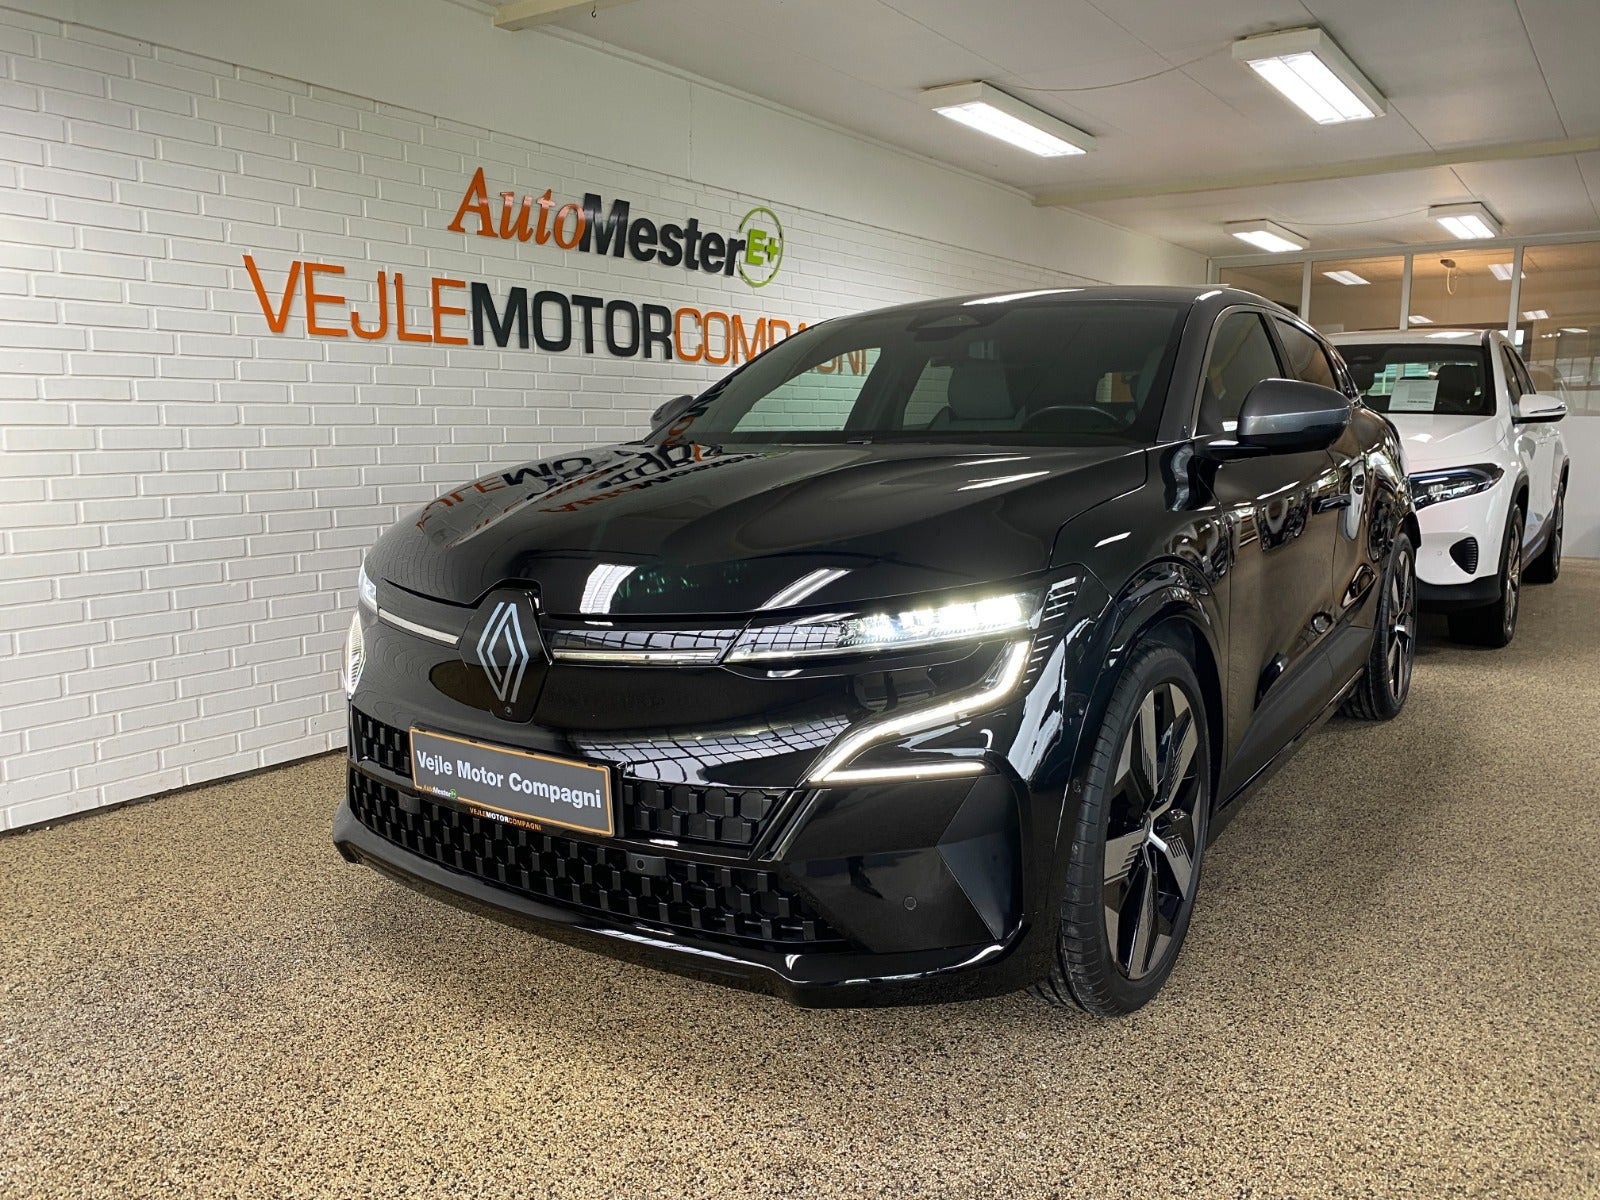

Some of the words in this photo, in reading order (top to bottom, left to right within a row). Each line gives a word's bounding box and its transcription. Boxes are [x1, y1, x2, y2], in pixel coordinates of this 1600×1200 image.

[448, 166, 746, 277] AutoMester
[416, 750, 453, 776] Vejle
[456, 760, 504, 788] Motor
[508, 772, 602, 809] Compagni
[469, 806, 543, 831] VEJLEMOTORCOMPAGNI
